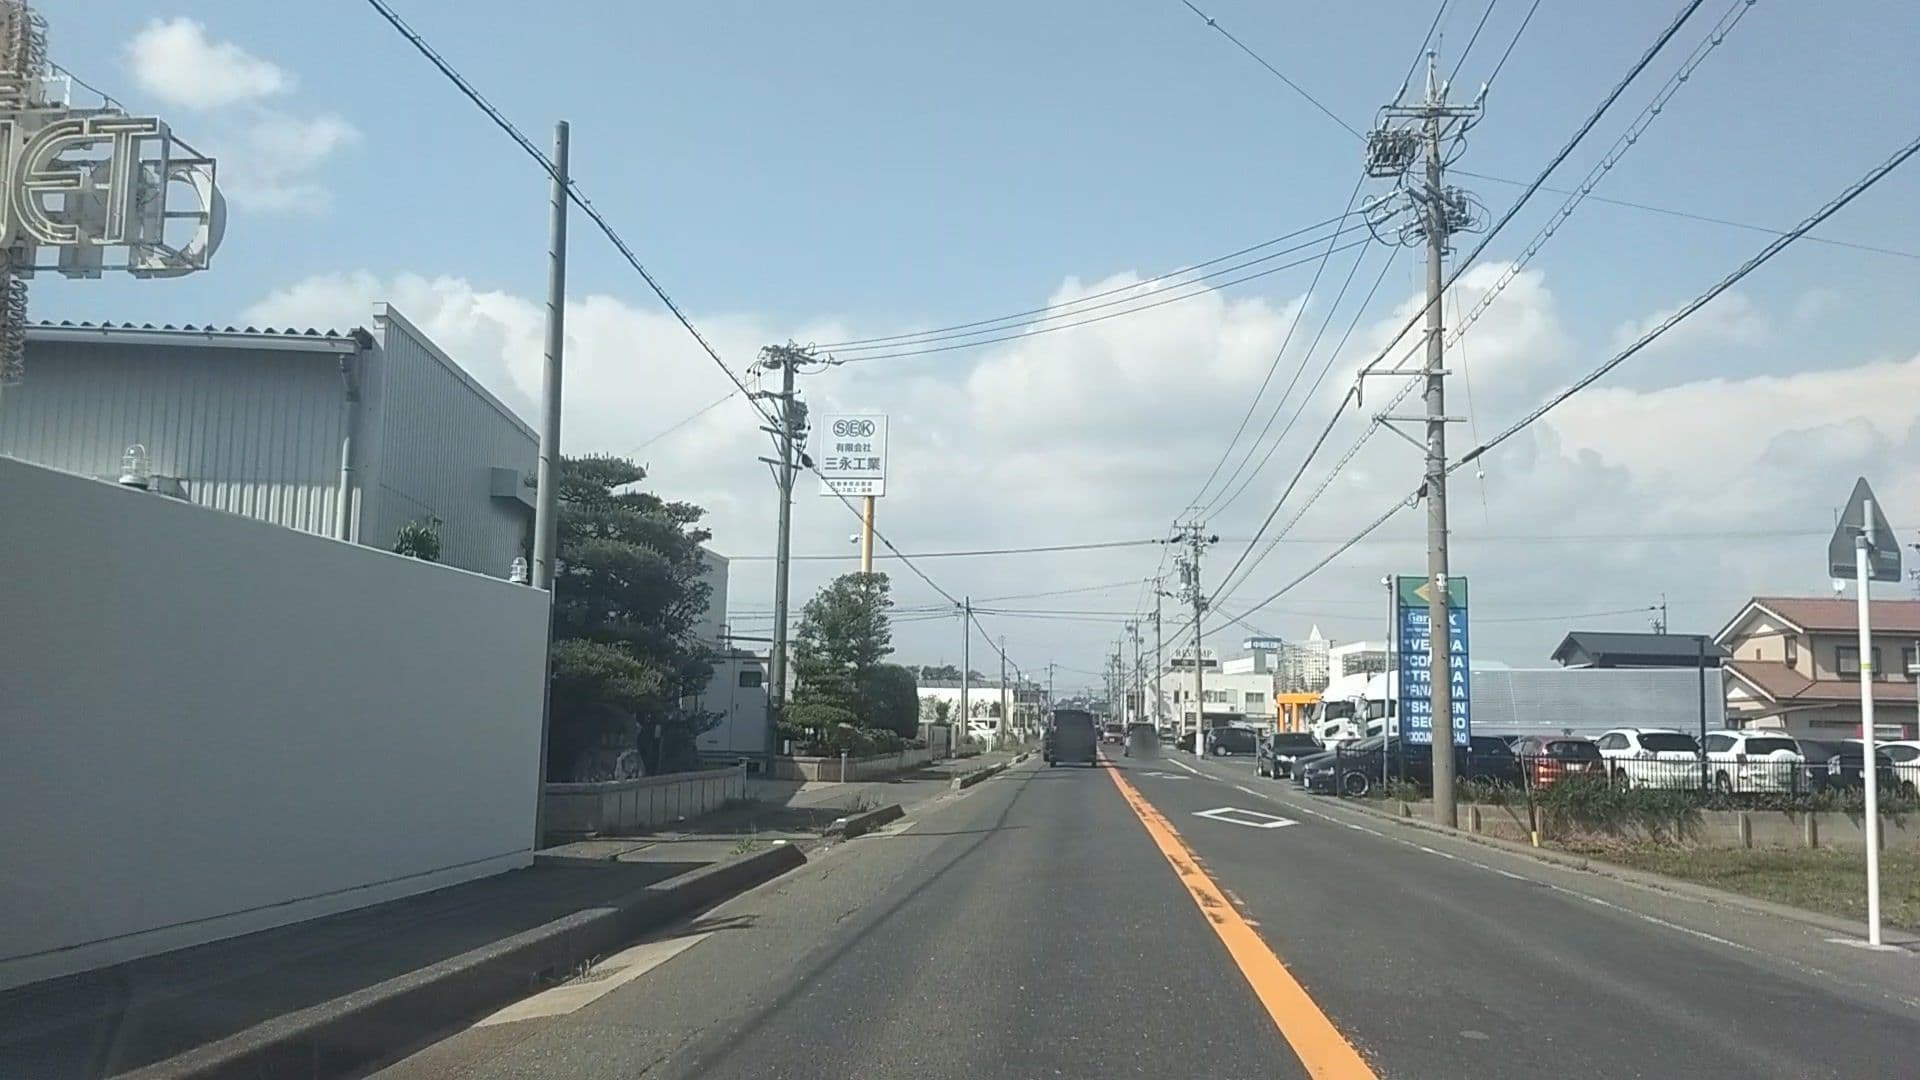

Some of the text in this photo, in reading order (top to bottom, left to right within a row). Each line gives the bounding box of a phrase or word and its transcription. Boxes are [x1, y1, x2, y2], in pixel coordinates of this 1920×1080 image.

[834, 421, 874, 436] SEK
[836, 443, 871, 453] 有限会社
[824, 456, 880, 471] 三永工業
